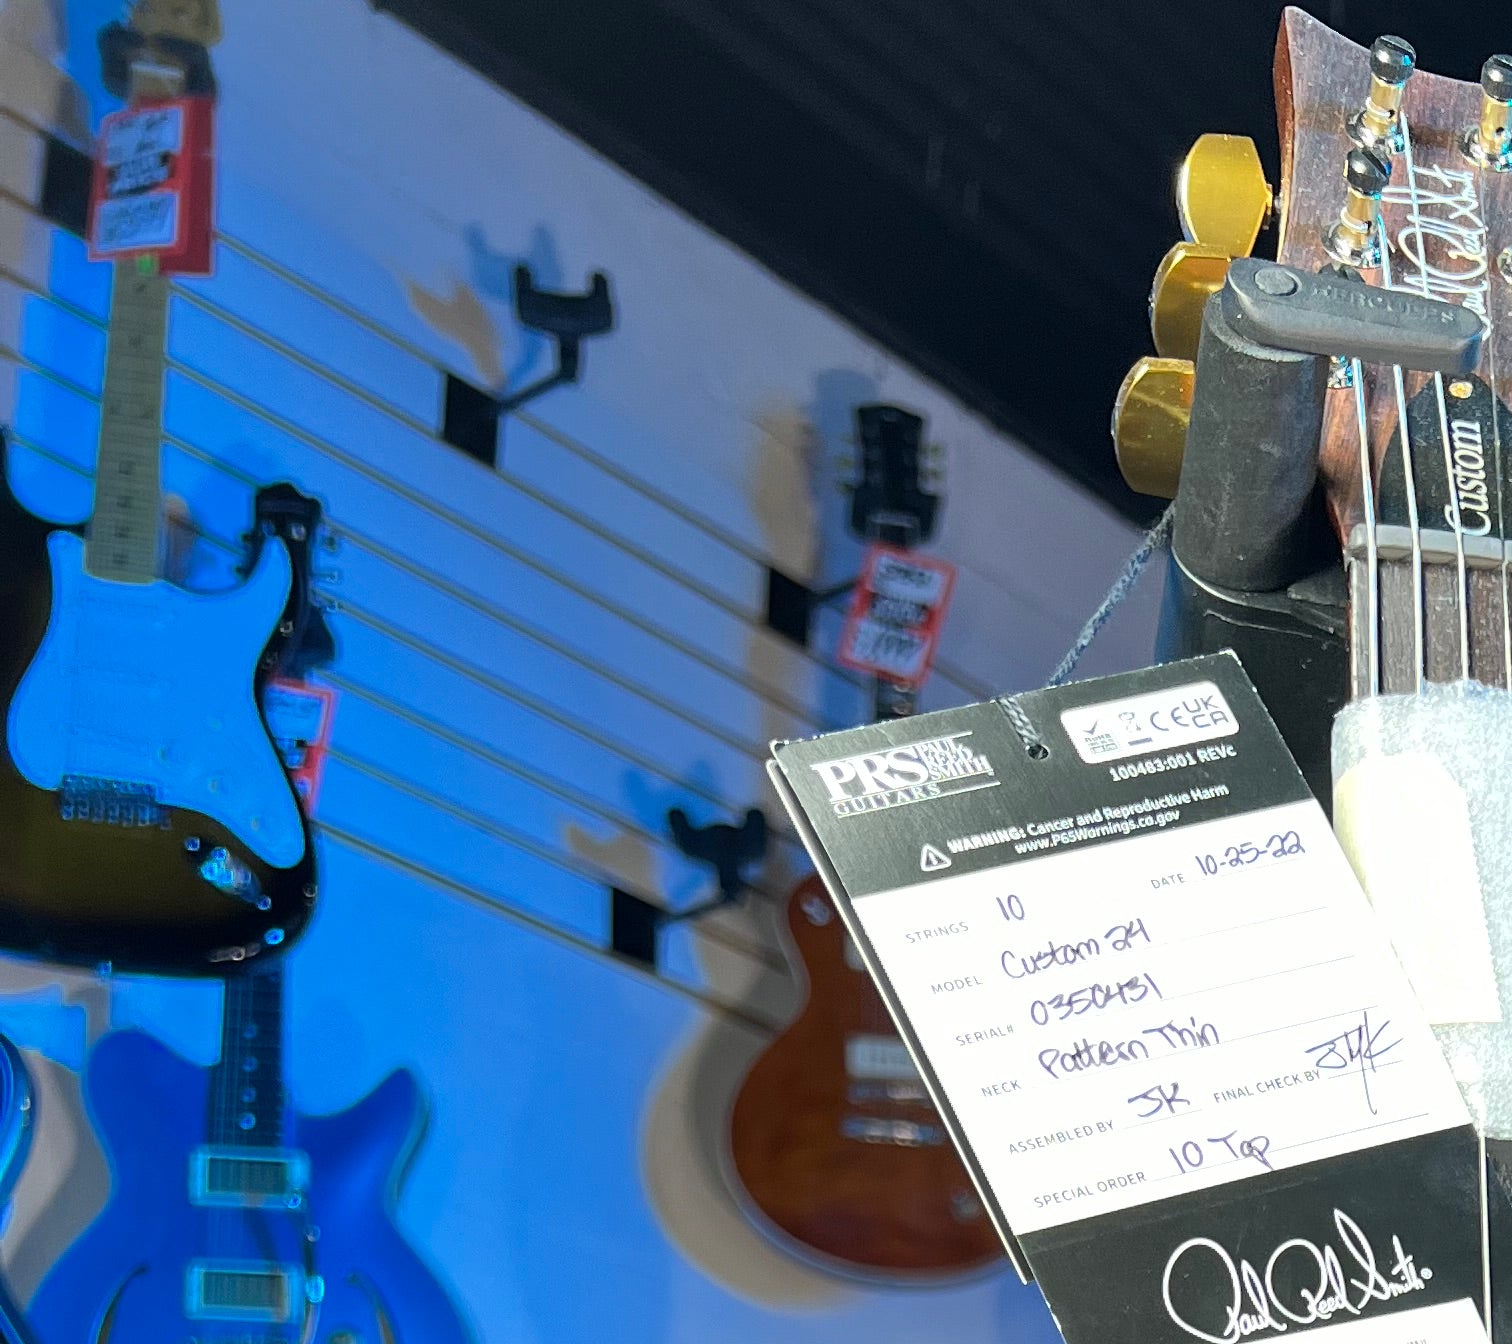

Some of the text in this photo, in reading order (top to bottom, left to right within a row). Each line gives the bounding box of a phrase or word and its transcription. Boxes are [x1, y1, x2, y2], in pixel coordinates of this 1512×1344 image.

[1444, 419, 1491, 536] Custom
[1182, 695, 1219, 714] UK
[1191, 710, 1229, 729] CA
[811, 747, 929, 802] PRS
[927, 755, 992, 781] SMITH
[833, 783, 941, 815] GUITARS
[947, 783, 1229, 854] WARNING: Cancer and Reproductive Harm
[1195, 830, 1306, 876] 10-25-22
[1151, 873, 1186, 889] DATE
[996, 894, 1025, 921] 10
[906, 921, 969, 944] STRINGS
[1001, 918, 1152, 979] Custom 24
[931, 975, 983, 995] MODEL
[1030, 973, 1163, 1026] 0350431
[955, 1024, 1015, 1047] SERIAL#
[1038, 1016, 1220, 1079] Pattern Thin
[980, 1079, 1022, 1098] NECK
[1213, 1068, 1322, 1104] FINAL CHECK BY
[1008, 1119, 1115, 1156] ASSEMBLED BY
[1169, 1130, 1275, 1175] 10 Top
[1033, 1170, 1147, 1209] SPECIAL ORDER
